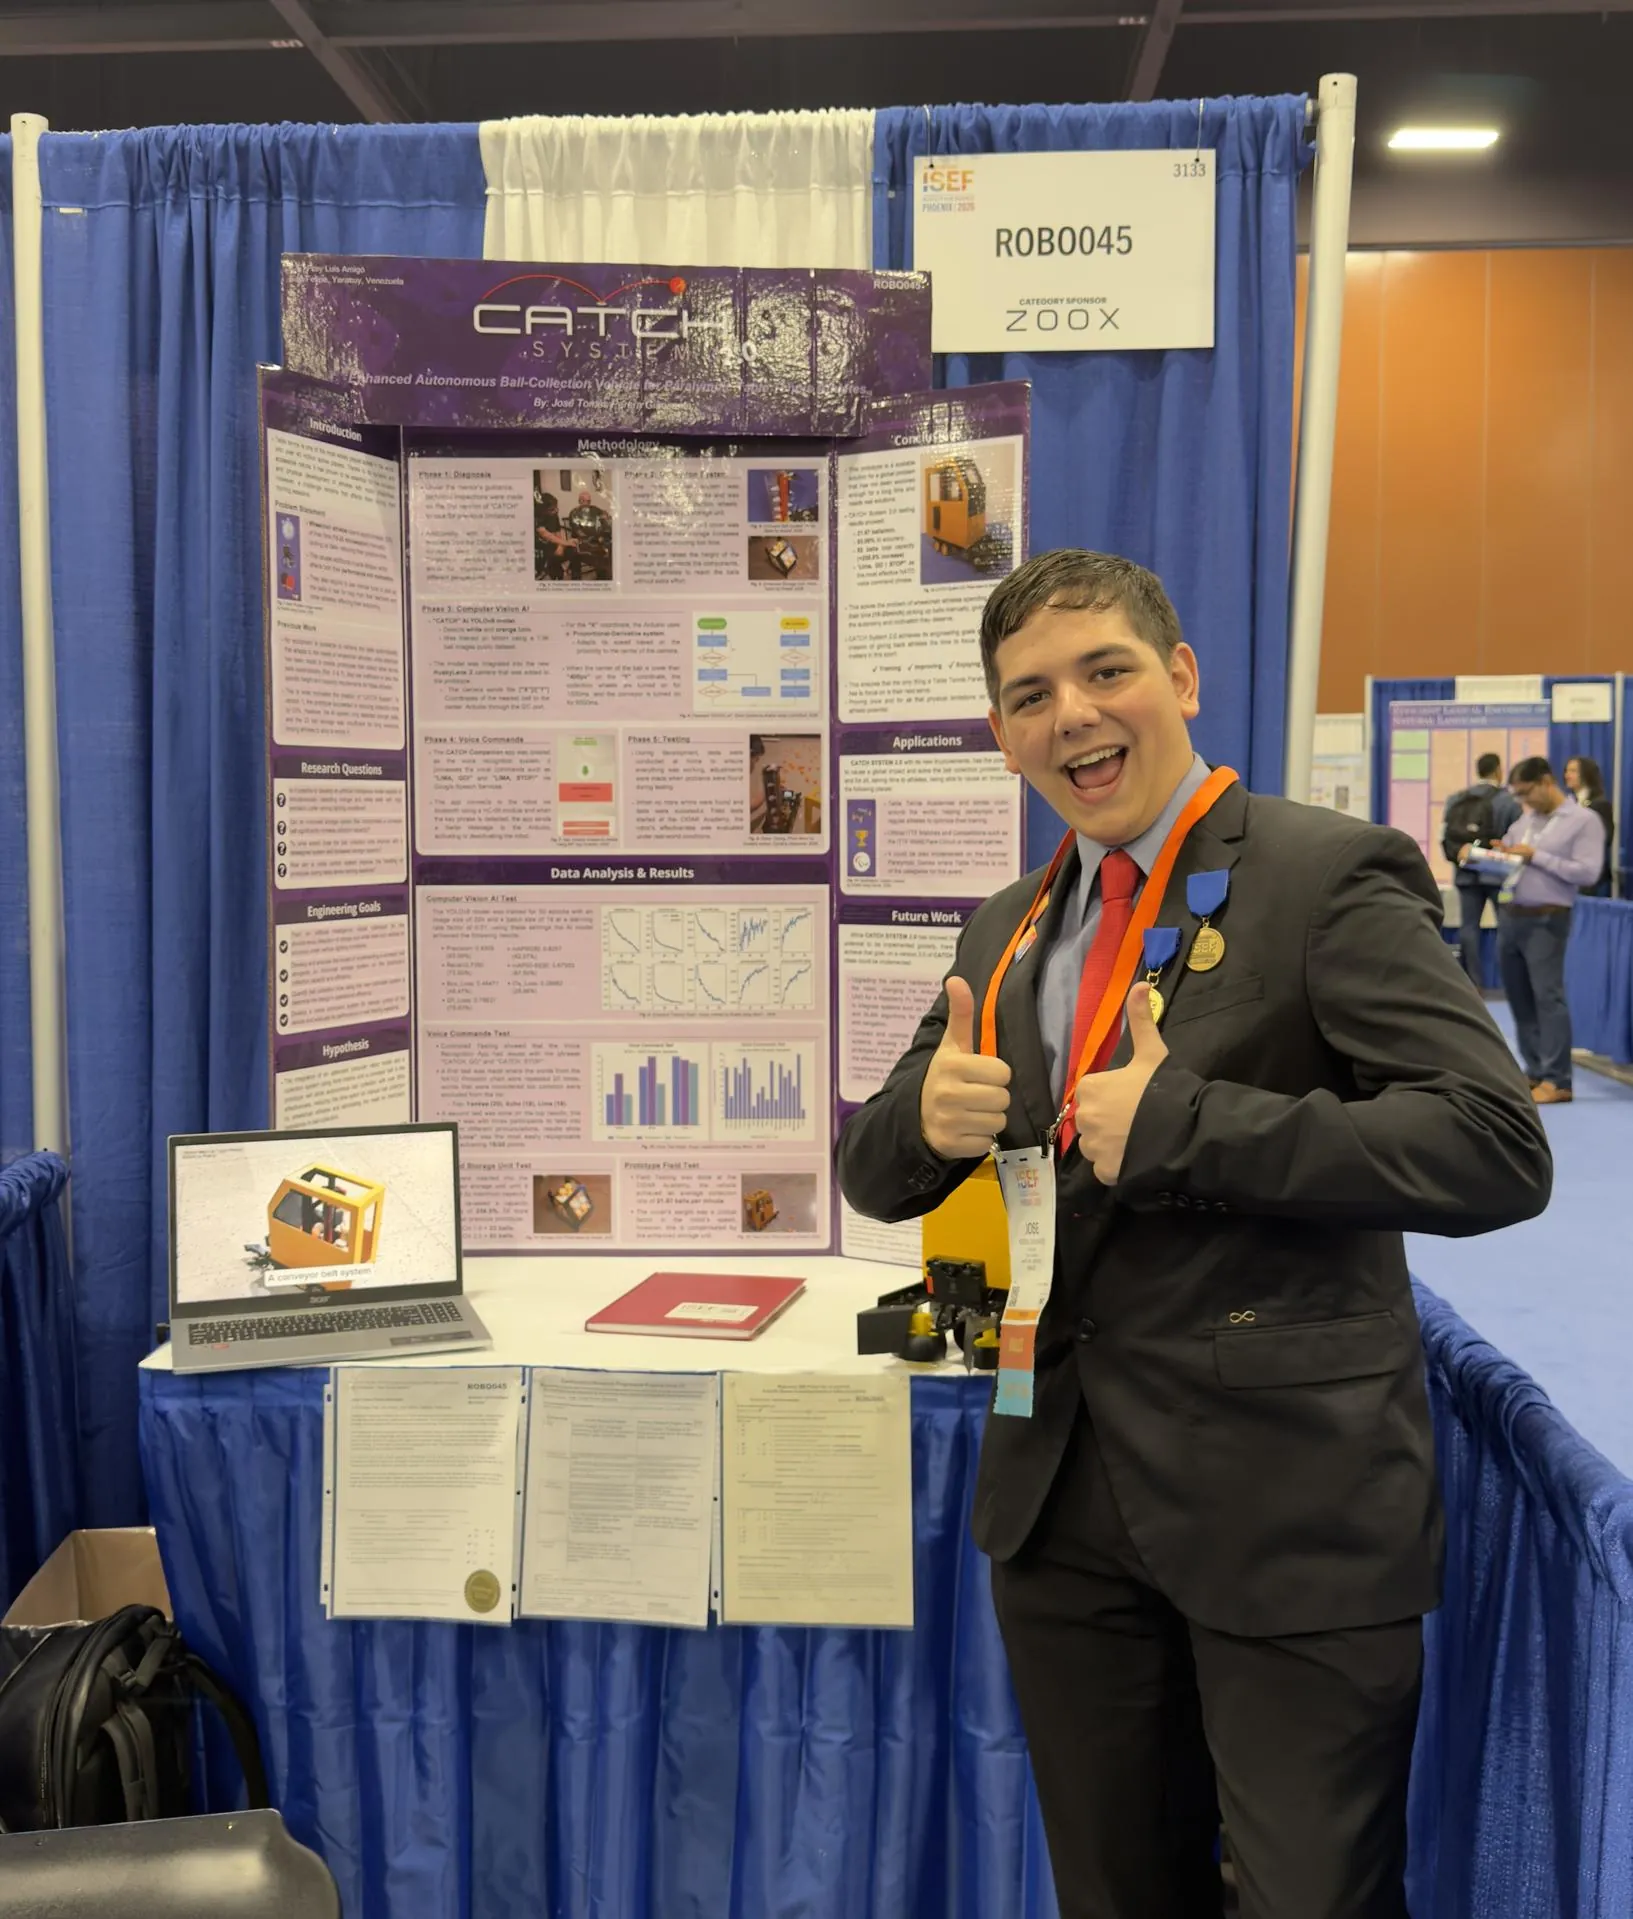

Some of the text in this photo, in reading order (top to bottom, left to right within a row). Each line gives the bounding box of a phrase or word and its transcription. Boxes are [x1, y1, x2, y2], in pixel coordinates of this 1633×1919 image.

[1174, 163, 1206, 178] 3133
[995, 225, 1133, 257] ROBO045
[365, 277, 404, 285] Venezuela
[1019, 298, 1064, 306] CATEGORY
[473, 302, 729, 340] CATCH
[1006, 308, 1120, 331] ZOOX
[532, 341, 690, 361] SYSTEM
[347, 373, 412, 386] Enhanced
[416, 374, 497, 388] Autonomous
[499, 376, 592, 391] Ball-Collection
[534, 397, 549, 408] By:
[551, 397, 574, 408] José
[309, 418, 362, 442] Introduction
[577, 438, 661, 453] Methodology
[454, 471, 491, 479] Diagnosis
[663, 736, 690, 744] Testing
[893, 736, 962, 750] Applications
[301, 762, 382, 776] Research Questions
[551, 867, 695, 882] Data Analysis & Results
[308, 901, 381, 920] Engineering Goals
[892, 910, 961, 923] Future Work
[322, 1039, 369, 1058] Hypothesis
[467, 1162, 496, 1170] Storage
[277, 1271, 319, 1281] conveyor
[320, 1269, 338, 1277] belt
[340, 1268, 371, 1277] system
